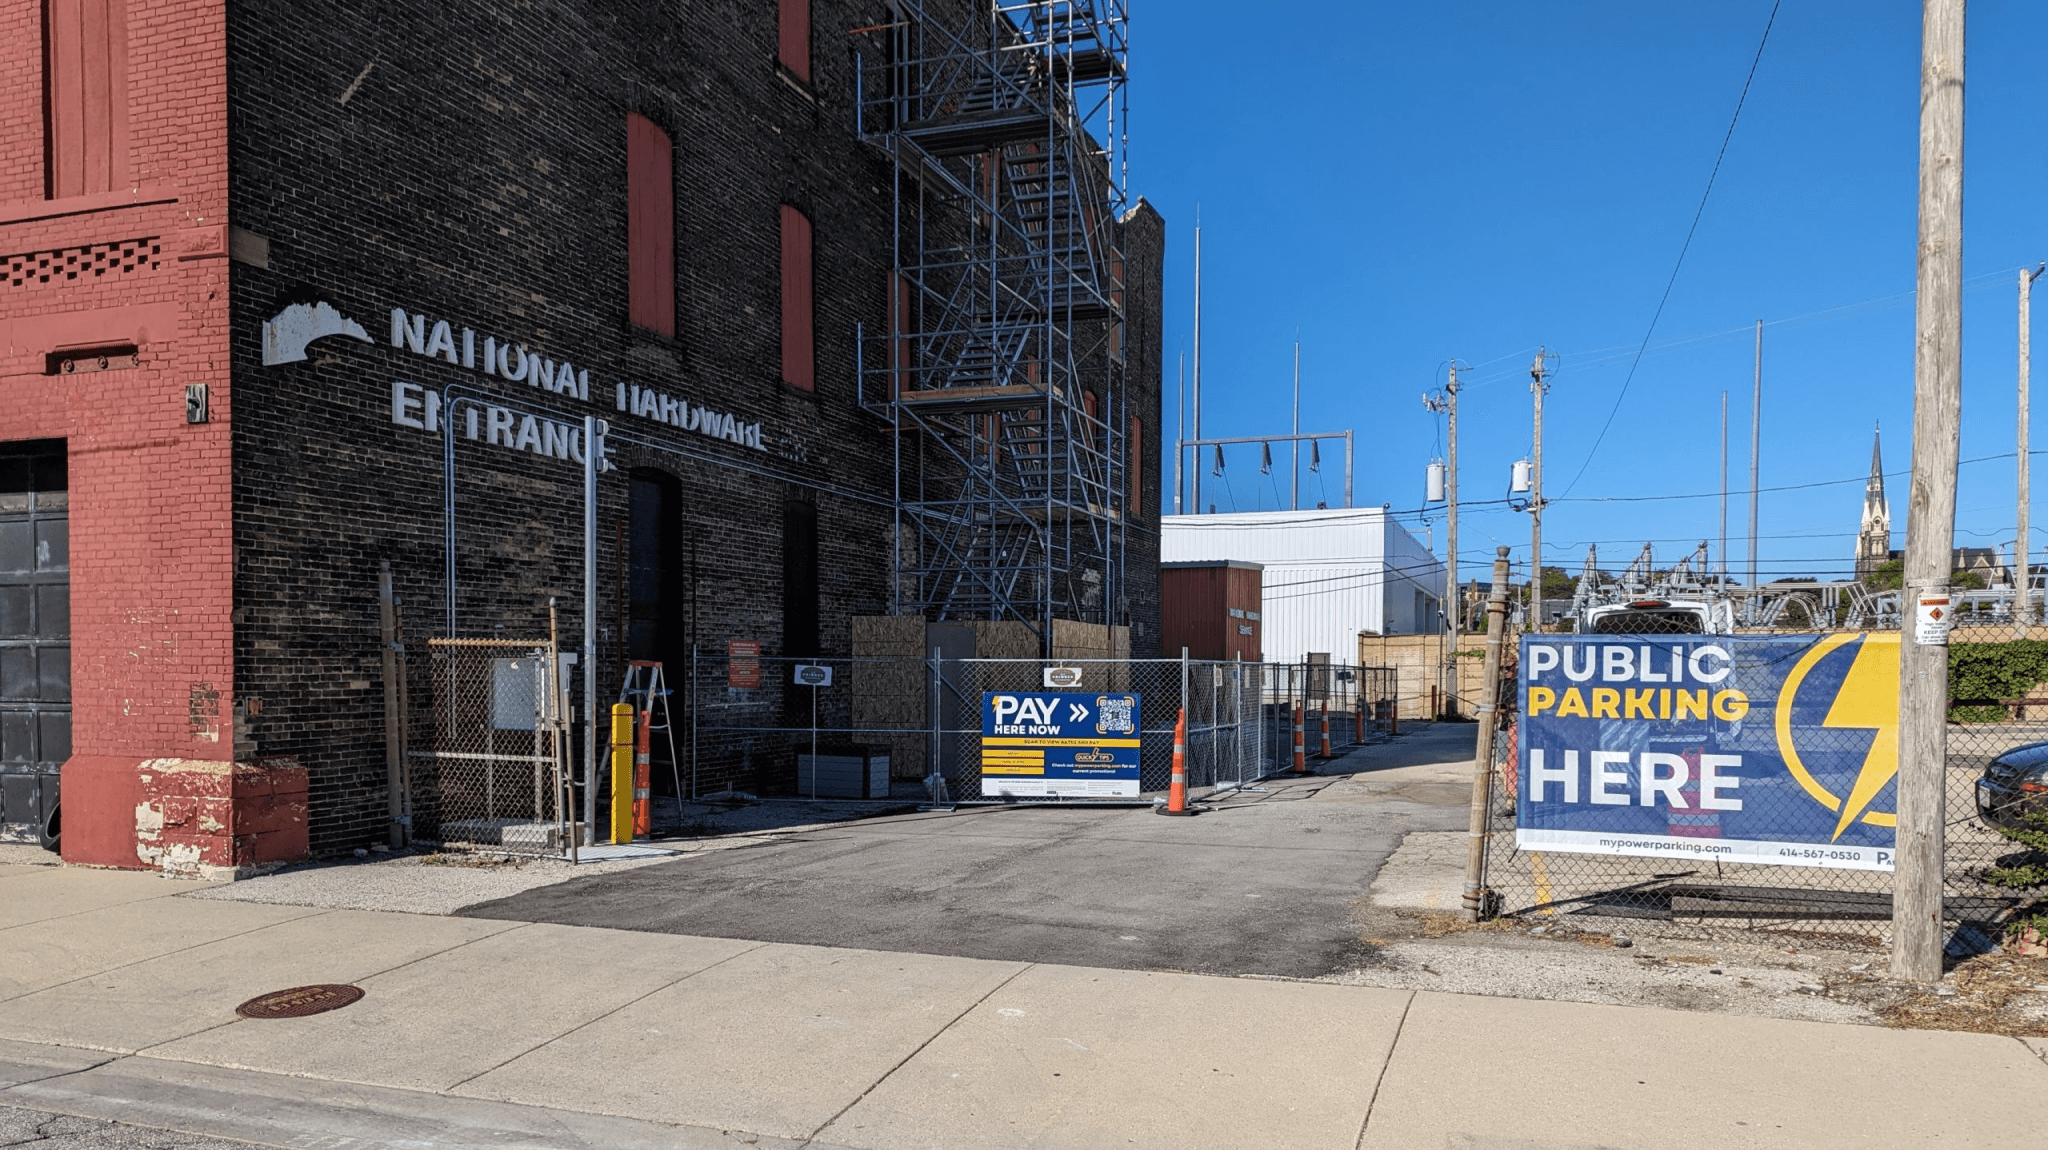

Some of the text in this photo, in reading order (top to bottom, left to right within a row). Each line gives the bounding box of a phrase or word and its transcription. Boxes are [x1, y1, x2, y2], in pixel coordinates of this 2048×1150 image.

[1528, 645, 1731, 684] PUBLIC
[995, 695, 1061, 726] PAY
[1528, 686, 1751, 722] PARKING
[994, 725, 1061, 736] HERE NOW
[1529, 748, 1744, 812] HERE
[1599, 836, 1732, 854] mypowerparking.com
[1779, 848, 1861, 861] 414-567-0530
